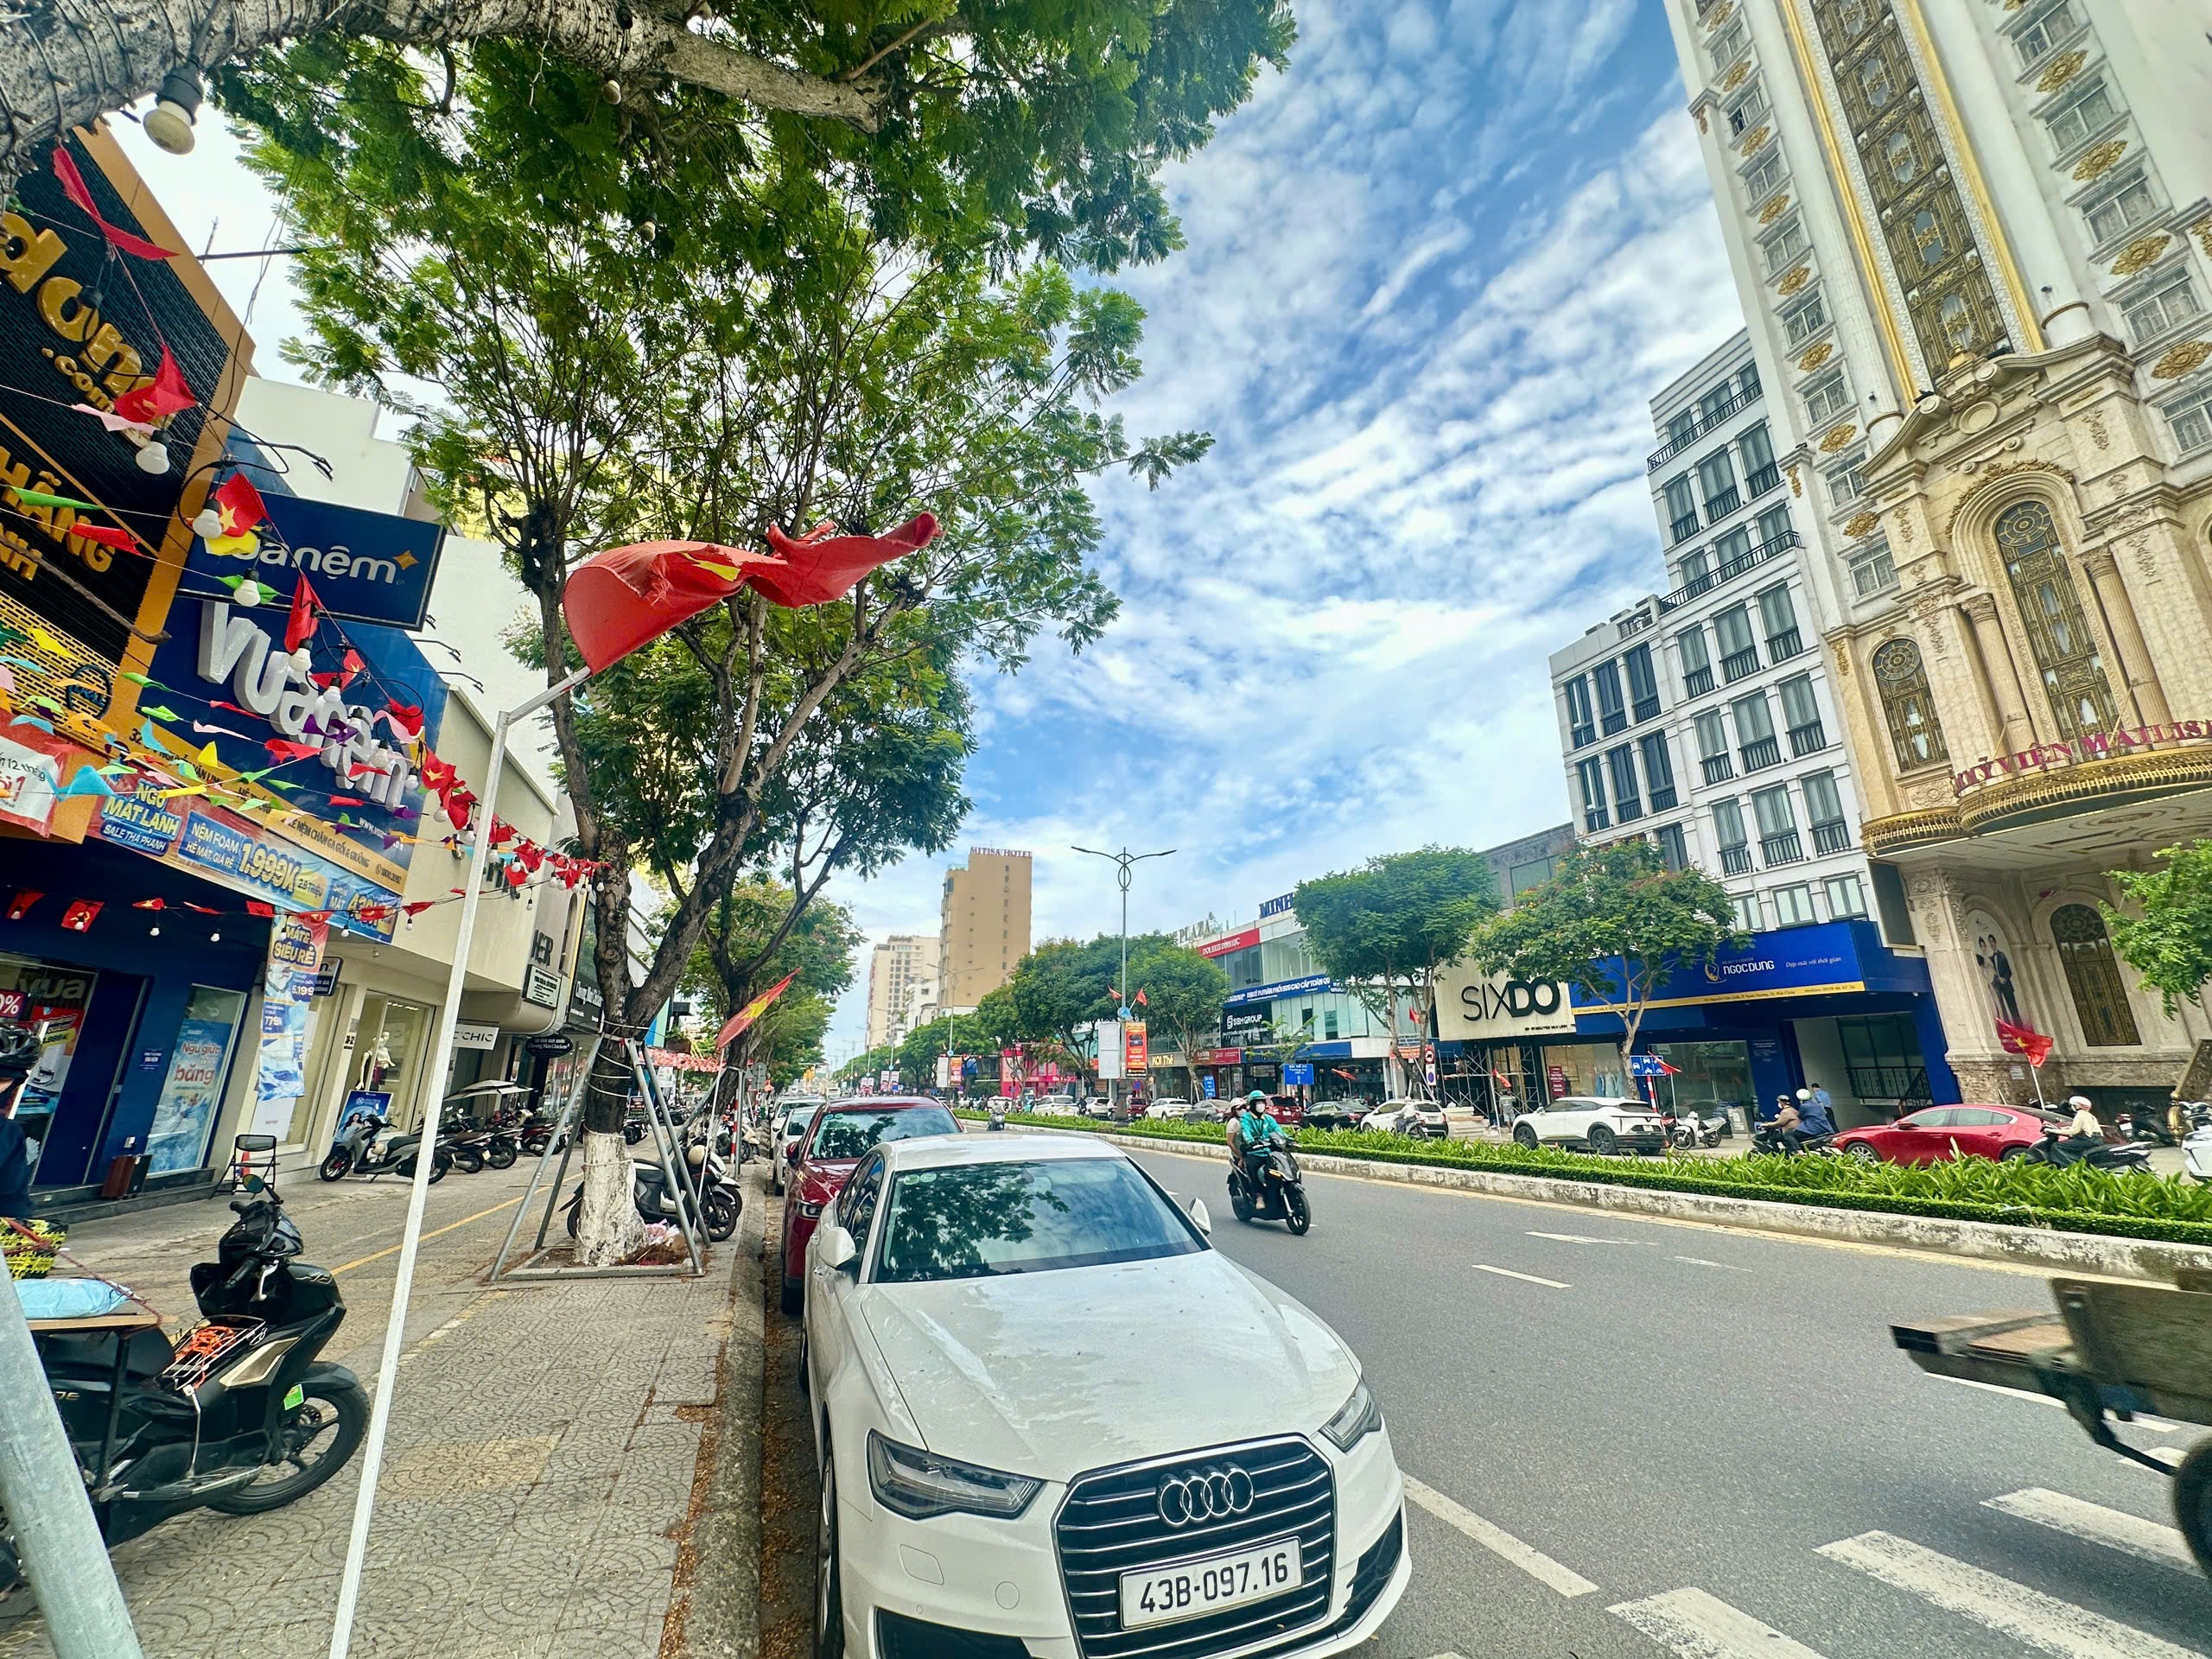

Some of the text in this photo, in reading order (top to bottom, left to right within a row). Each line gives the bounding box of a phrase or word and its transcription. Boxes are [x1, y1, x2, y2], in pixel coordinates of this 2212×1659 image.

[1994, 741, 2074, 774] VIỆN
[104, 794, 181, 836] MÁT LẠNH
[103, 823, 125, 839] SALE
[212, 832, 240, 854] FOAM
[969, 846, 1033, 858] MITISA HOTEL
[238, 842, 301, 893] 1.999K
[1748, 960, 1775, 973] DUNG
[1460, 976, 1560, 1021] SIXDO
[1243, 1014, 1262, 1024] GROUP
[1152, 1056, 1162, 1065] KOI
[1140, 1552, 1288, 1613] 43B-097.16
